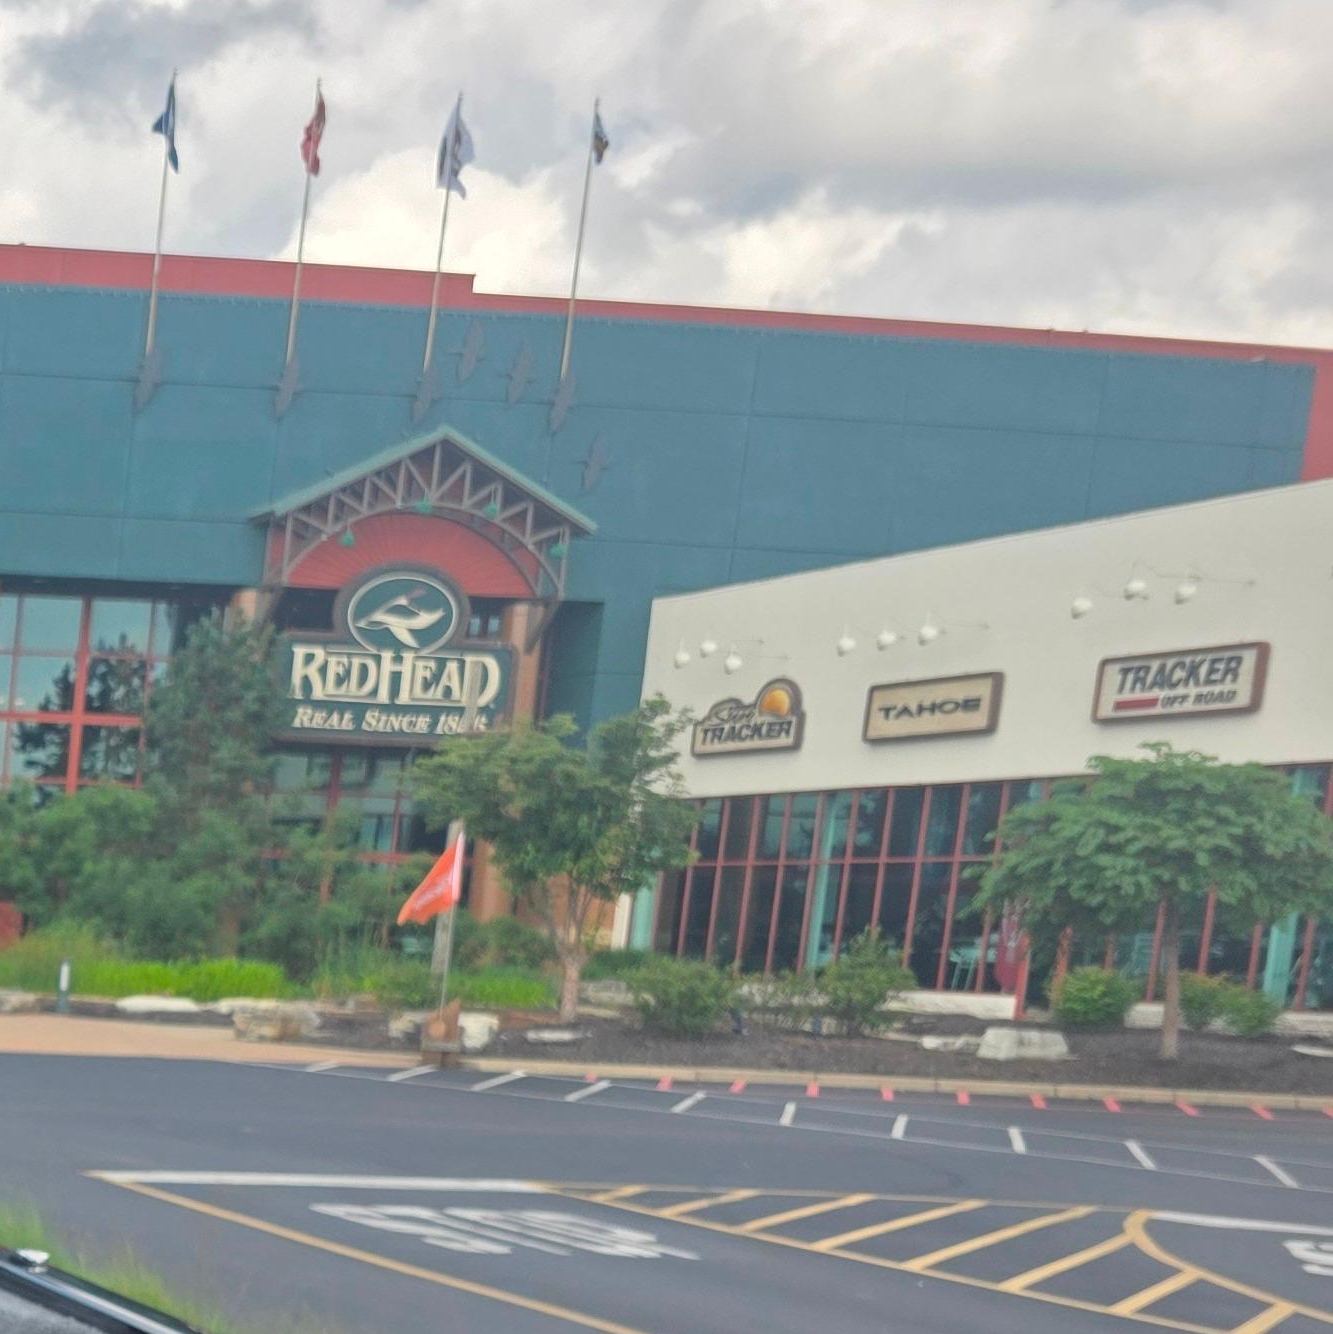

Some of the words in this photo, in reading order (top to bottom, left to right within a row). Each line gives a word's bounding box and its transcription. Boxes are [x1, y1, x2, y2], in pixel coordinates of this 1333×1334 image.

[1117, 655, 1243, 694] TRACKER
[878, 697, 982, 721] TAHOE
[1161, 694, 1191, 709] OFF
[1192, 689, 1238, 705] ROAD
[701, 719, 793, 746] TRACKER
